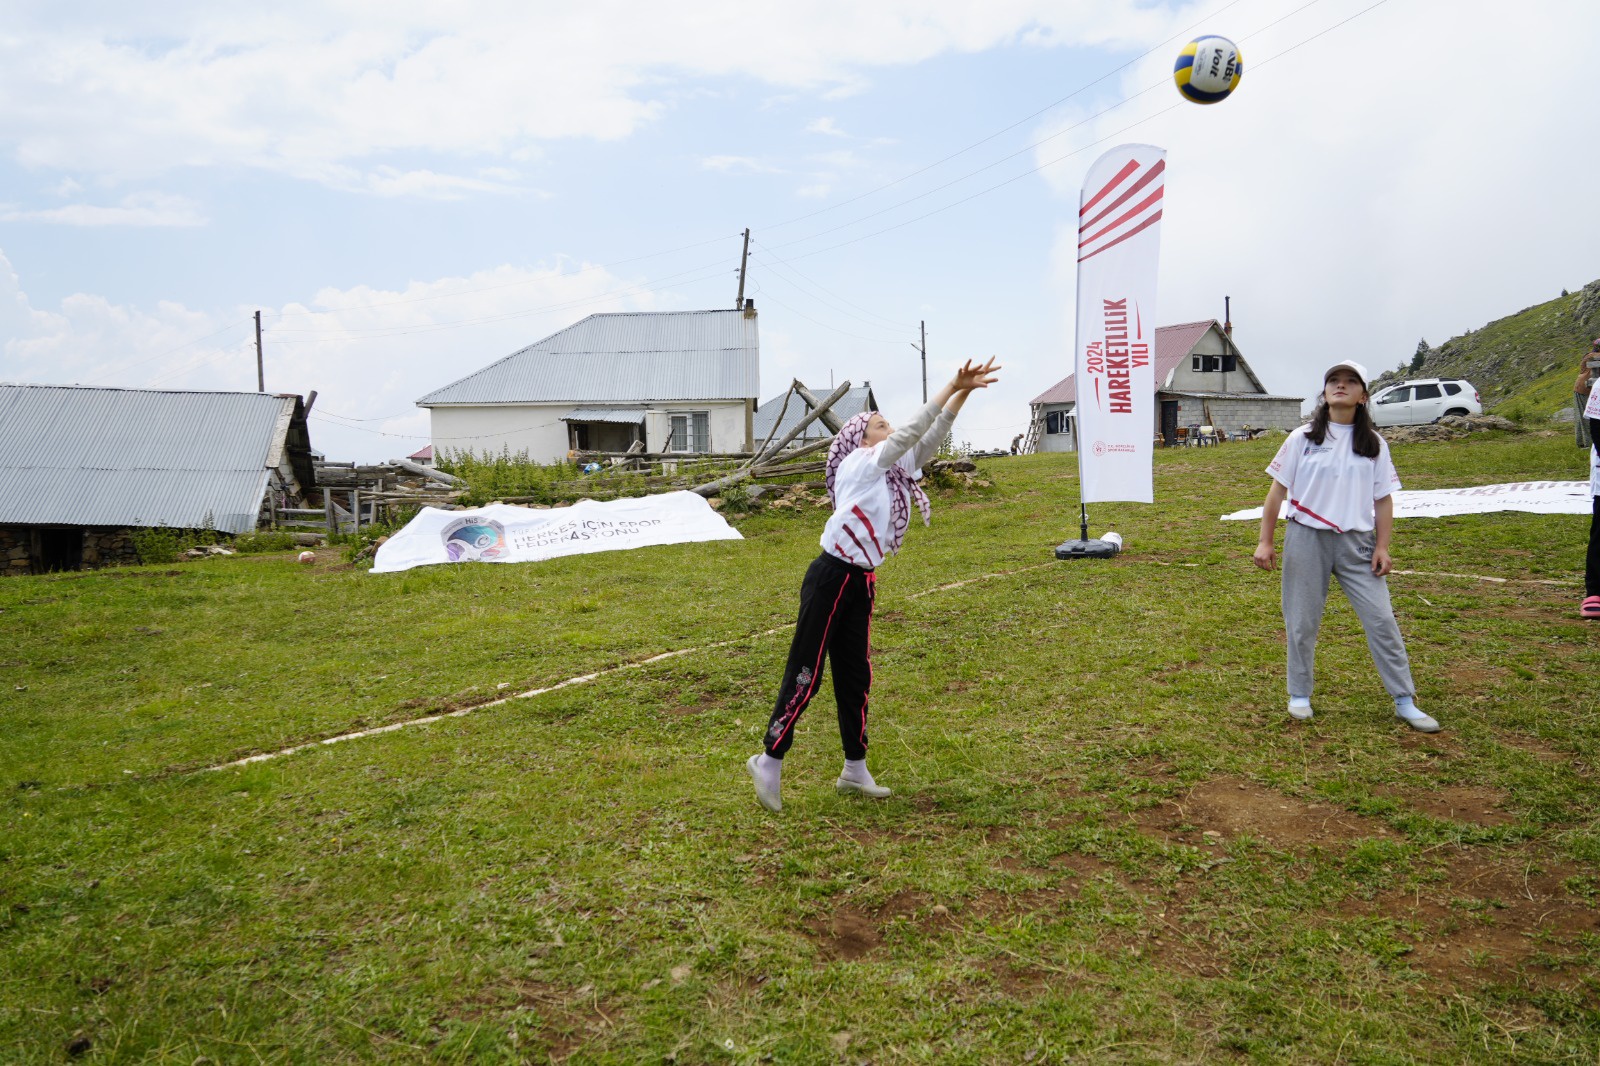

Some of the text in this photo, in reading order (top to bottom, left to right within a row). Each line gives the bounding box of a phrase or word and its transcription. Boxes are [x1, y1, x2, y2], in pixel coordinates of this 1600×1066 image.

[1210, 48, 1223, 78] Voit
[1086, 341, 1104, 374] 2024
[1103, 297, 1132, 414] HAREKETLİLİK
[1131, 343, 1149, 368] YILI
[514, 519, 578, 543] HERKES
[582, 518, 614, 531] İÇİN
[619, 519, 662, 528] SPOR
[516, 528, 640, 549] FEDERASYONU
